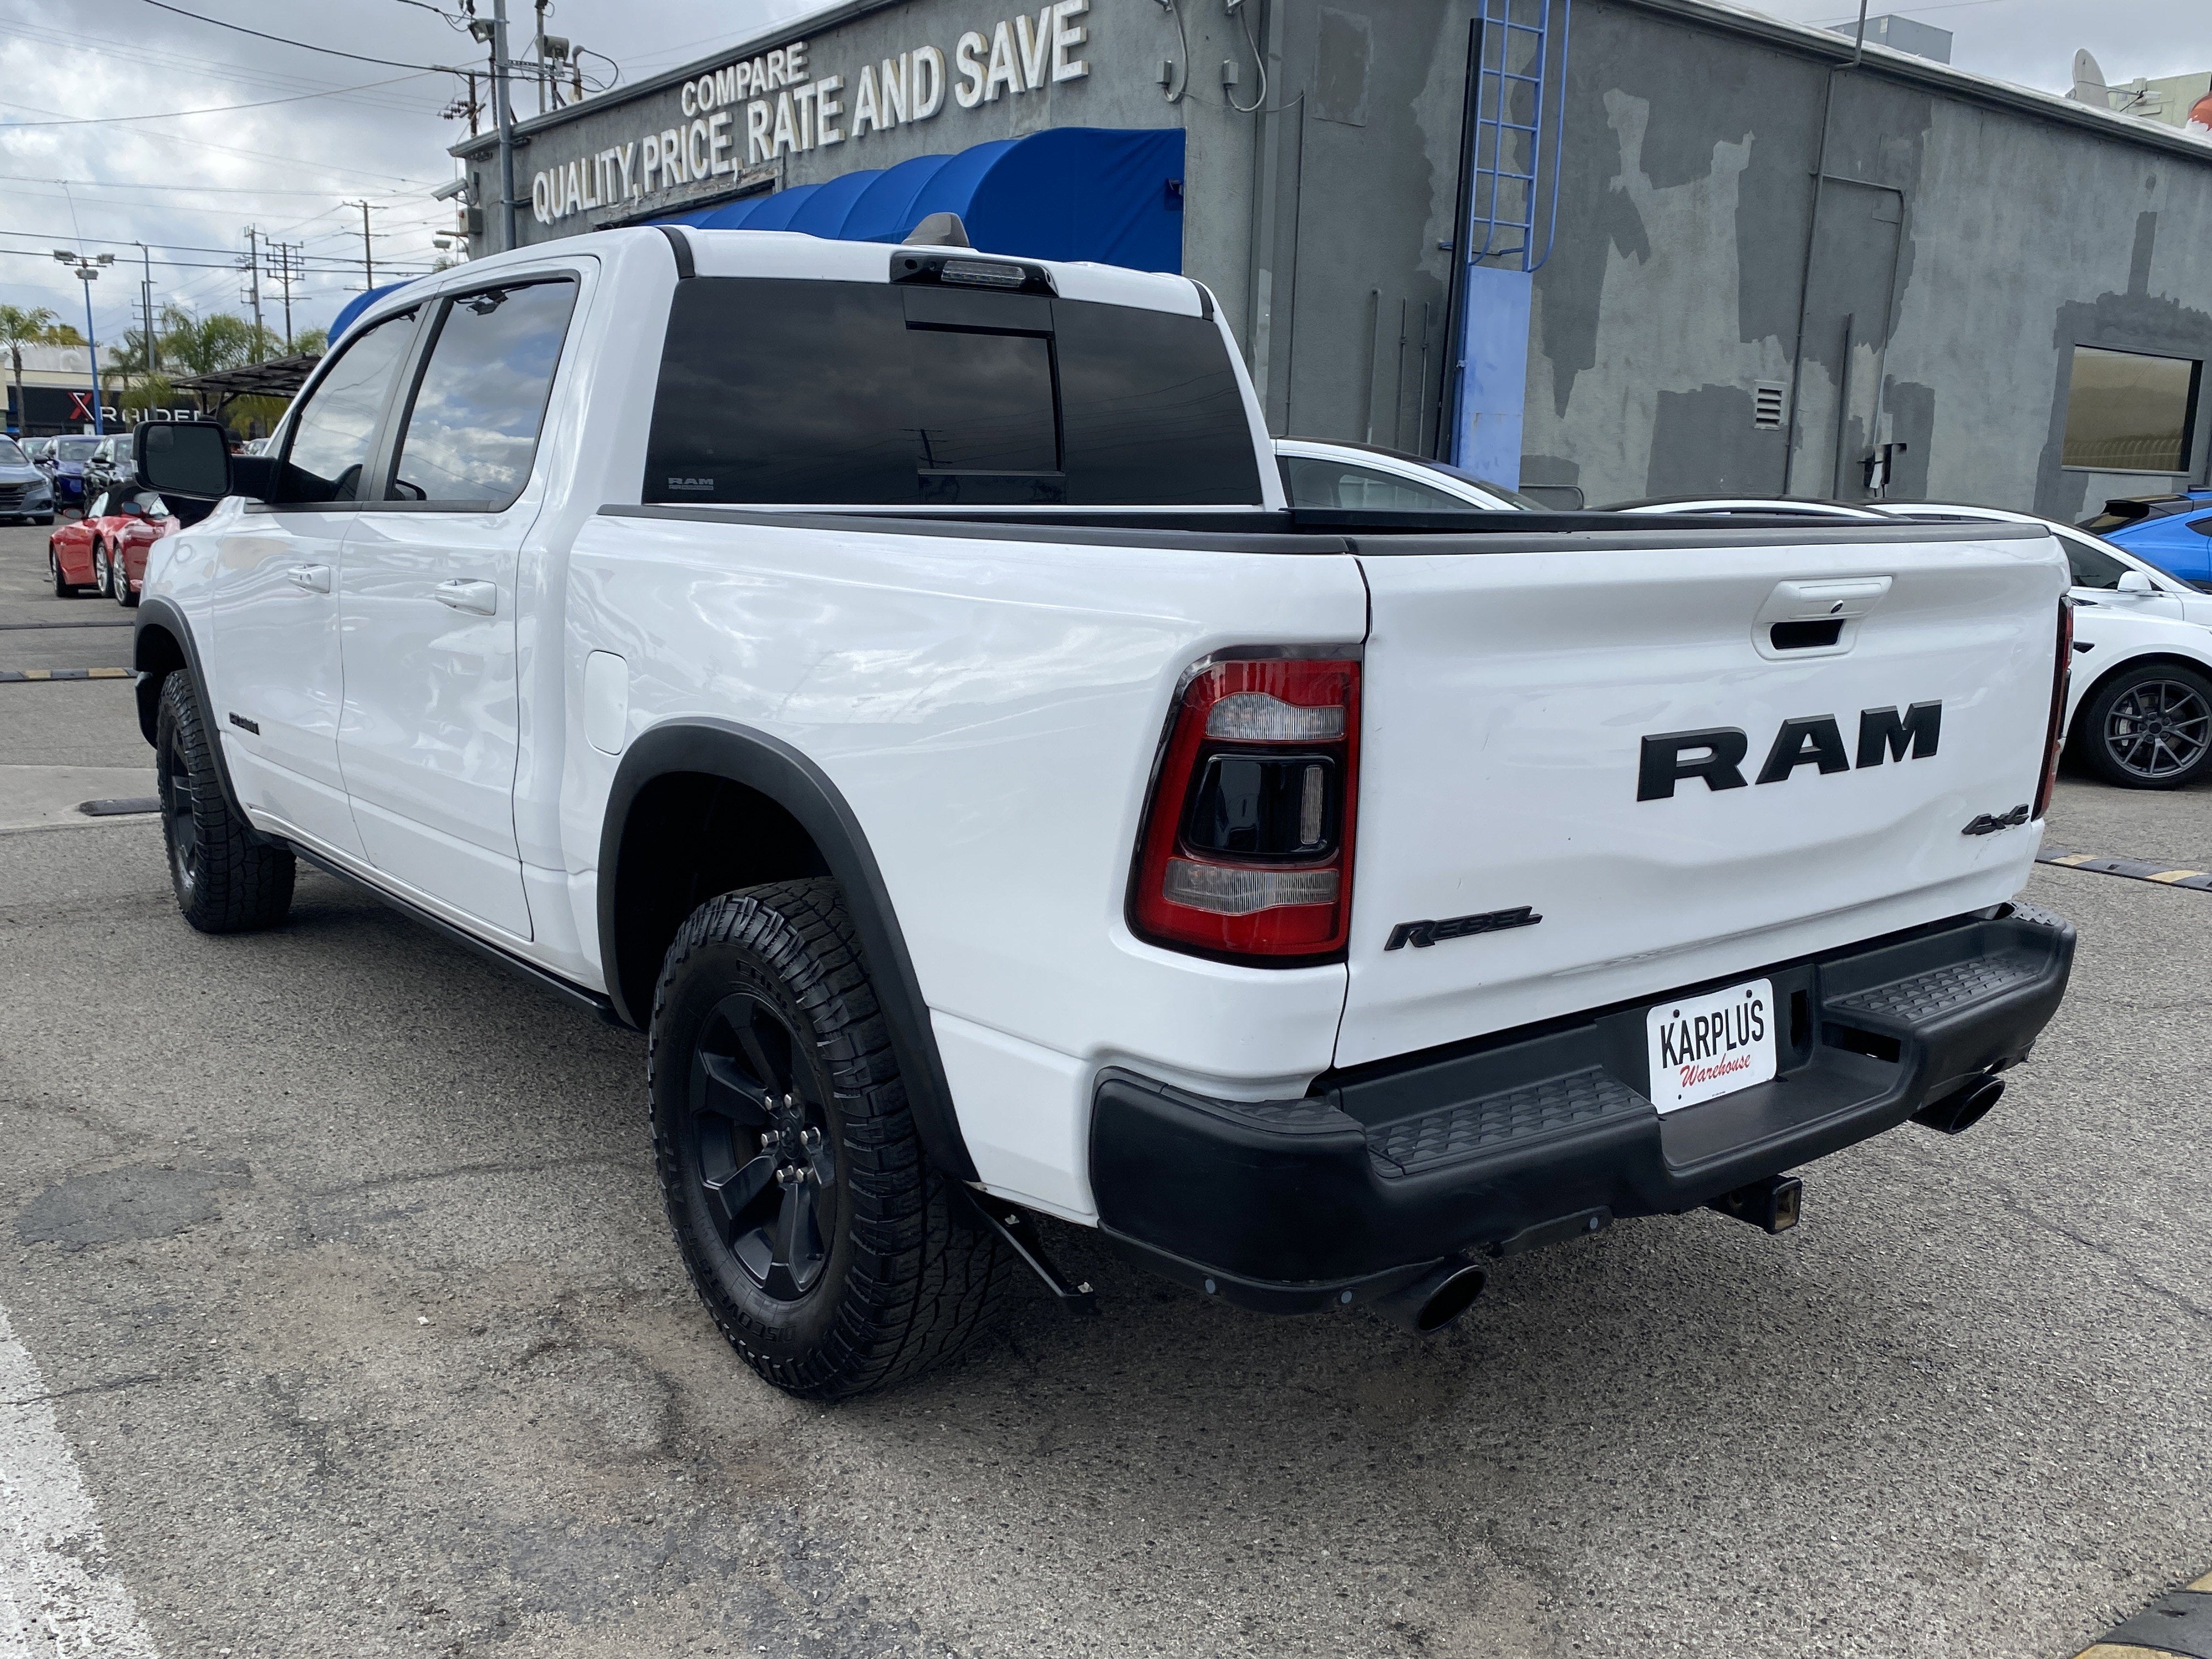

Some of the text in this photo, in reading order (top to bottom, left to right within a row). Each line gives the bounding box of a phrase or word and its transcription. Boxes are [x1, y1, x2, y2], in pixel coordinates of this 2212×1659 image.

[681, 41, 809, 117] COMPARE
[747, 75, 845, 164] RATE
[851, 46, 946, 137] AND
[955, 0, 1089, 109] SAVE
[1637, 699, 1942, 802] RAM
[1660, 1000, 1764, 1069] KARPLUS
[1680, 1053, 1751, 1088] Warehouse
